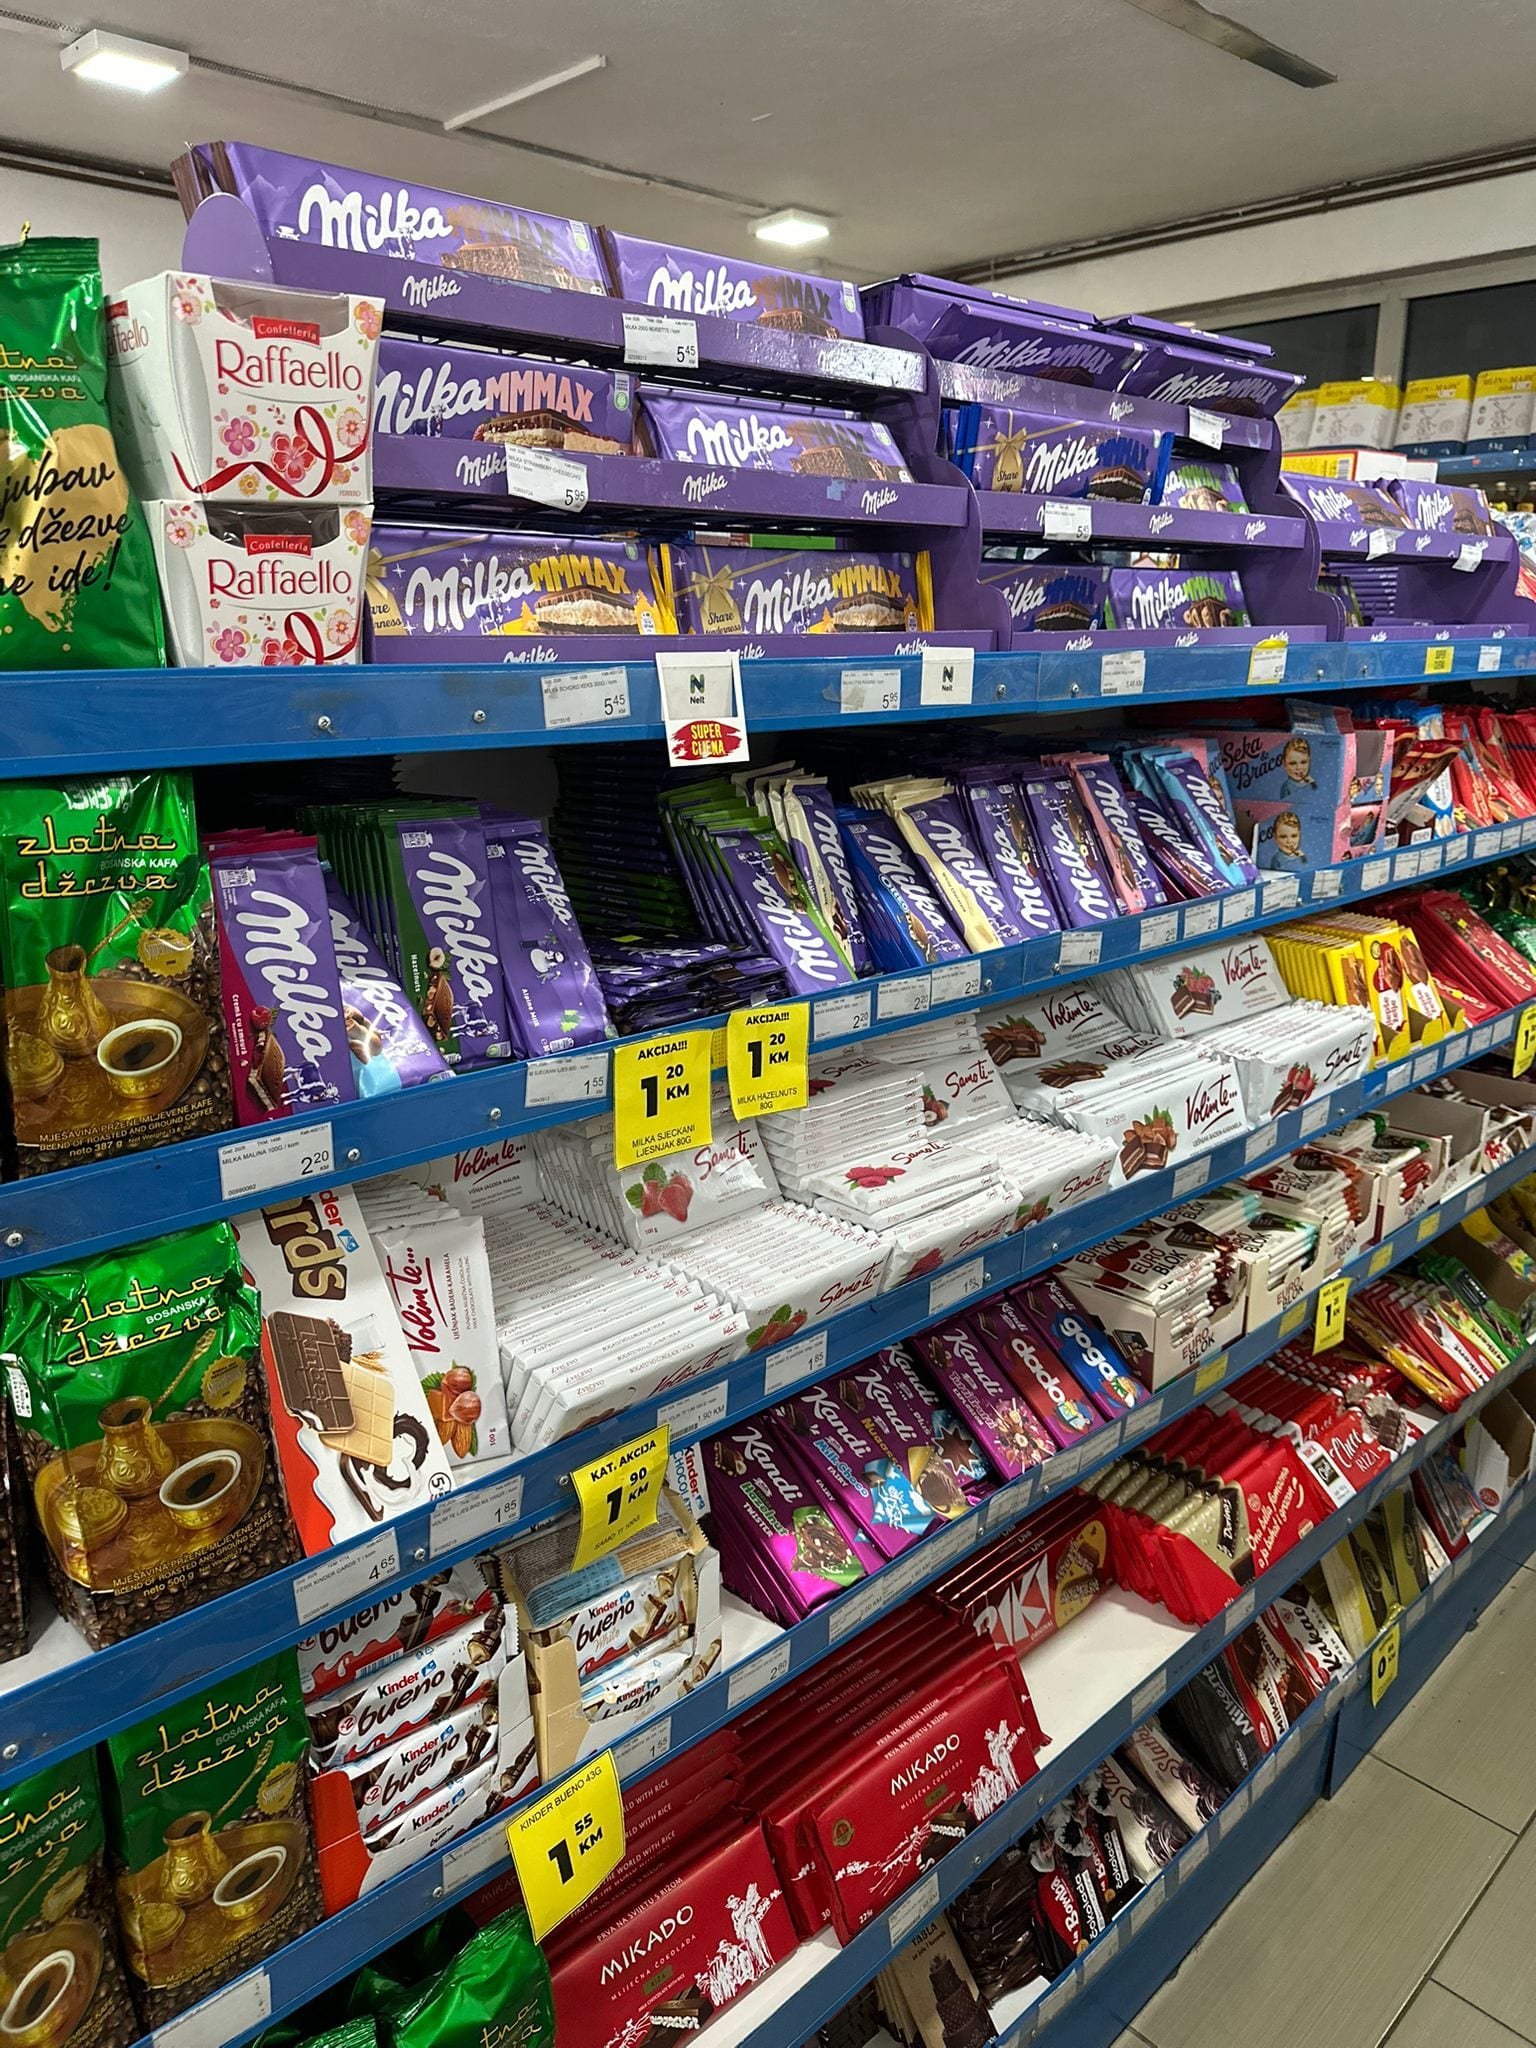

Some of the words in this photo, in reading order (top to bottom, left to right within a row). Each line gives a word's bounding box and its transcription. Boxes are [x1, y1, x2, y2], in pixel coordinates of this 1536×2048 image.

[401, 274, 462, 308] Milka
[646, 265, 757, 315] Milka
[257, 323, 317, 341] Confetteria
[215, 339, 362, 391] Raffaello
[374, 361, 489, 434] Milka
[485, 370, 594, 422] MMMAX
[1026, 437, 1100, 494] Milka
[682, 471, 729, 502] Milka
[861, 487, 899, 515] Milka
[249, 538, 310, 556] Confetteria
[207, 558, 352, 598] Raffaello
[405, 555, 537, 633] Milka
[529, 554, 632, 595] MMMAX
[707, 611, 735, 626] Share
[743, 568, 836, 634] Milka
[831, 564, 902, 598] MMMAX
[689, 695, 705, 705] Nelt
[690, 723, 721, 740] SUPER
[691, 738, 725, 757] CIJENA
[1221, 735, 1263, 772] Seka
[1231, 751, 1285, 791] Braco
[17, 815, 177, 857] zlatna
[1095, 779, 1146, 871] Milka
[100, 858, 146, 870] BOSANSKA
[149, 857, 178, 870] KAFA
[513, 839, 573, 926] Milka
[866, 834, 945, 932] Milka
[928, 819, 1001, 918] Milka
[993, 826, 1051, 930] Milka
[1051, 818, 1108, 920] Milka
[416, 850, 499, 1007] Milka
[752, 872, 838, 981] Milka
[236, 890, 339, 1068] Milka
[409, 953, 421, 993] Hazelnuts
[521, 987, 534, 1013] Alpine
[529, 1011, 541, 1029] Milk
[746, 1012, 789, 1025] AKCIJA!!!
[637, 1040, 688, 1060] AKCIJA!!!
[769, 1033, 785, 1046] 20
[769, 1050, 789, 1065] KM
[666, 1064, 683, 1078] 20
[747, 1041, 762, 1079] 1
[641, 1075, 659, 1118] 1
[666, 1083, 690, 1100] KM
[737, 1094, 757, 1105] MILKA
[757, 1086, 797, 1102] HAZELNUTS
[760, 1101, 773, 1111] 80G
[129, 1126, 147, 1136] AND
[149, 1117, 184, 1131] GROUND
[185, 1106, 215, 1121] COFFEE
[632, 1134, 658, 1149] MILKA
[659, 1124, 696, 1143] SJECKANI
[222, 1155, 242, 1165] MILKA
[243, 1149, 266, 1159] MALINA
[301, 1156, 314, 1176] 2
[313, 1150, 329, 1164] 20
[636, 1141, 675, 1158] LJESNJAK
[676, 1136, 692, 1148] 80G
[444, 1252, 452, 1289] KARAMELA
[62, 1273, 226, 1334] zlatna
[145, 1297, 207, 1325] BOSANSKA
[447, 1289, 456, 1311] BADEM
[1045, 1280, 1078, 1312] Kandi
[997, 1301, 1029, 1333] Kandi
[943, 1327, 1004, 1397] Kandi
[1059, 1317, 1119, 1382] goga
[1182, 1327, 1209, 1360] EURO
[1188, 1332, 1215, 1365] BLOK
[887, 1342, 940, 1406] Kandi
[1011, 1338, 1066, 1404] dado
[801, 1386, 872, 1459] Kandi
[855, 1368, 918, 1442] Kandi
[590, 1462, 618, 1483] KAT.
[619, 1440, 657, 1467] AKCIJA
[629, 1466, 648, 1487] 90
[732, 1426, 803, 1504] Kandi
[606, 1487, 624, 1525] 1
[628, 1482, 650, 1504] KM
[739, 1481, 790, 1537] Hazelnut
[625, 1514, 641, 1531] 100G
[743, 1502, 774, 1538] TWISTER
[113, 1562, 170, 1588] MJEŠAVINA
[171, 1549, 208, 1568] PRŽENE
[209, 1524, 253, 1552] MLJEVENE
[254, 1510, 274, 1528] KAFE
[199, 1553, 215, 1564] AND
[216, 1537, 248, 1556] GROUND
[249, 1517, 275, 1538] COFFEE
[576, 1599, 635, 1652] bueno
[588, 1598, 619, 1621] Kinder
[357, 1667, 446, 1739] bueno
[377, 1670, 420, 1700] Kinder
[1202, 1664, 1255, 1737] Milkent
[136, 1682, 284, 1769] zlatna
[214, 1708, 264, 1747] BOSANSKA
[264, 1695, 289, 1717] KAFA
[883, 1744, 902, 1761] PRVA
[901, 1739, 911, 1750] NA
[931, 1710, 950, 1726] RIŽOM
[381, 1731, 461, 1806] bueno
[399, 1736, 440, 1768] Kinder
[890, 1733, 961, 1797] MIKADO
[519, 1801, 554, 1832] KINDER
[553, 1782, 586, 1813] BUENO
[585, 1765, 602, 1786] 43G
[636, 1789, 654, 1809] WITH
[654, 1778, 670, 1795] RICE
[412, 1797, 451, 1831] Kinder
[573, 1812, 594, 1837] 55
[578, 1826, 604, 1857] KM
[616, 1853, 642, 1877] WORLD
[641, 1841, 661, 1860] WITH
[660, 1829, 677, 1847] RICE
[547, 1838, 575, 1886] 1
[596, 1928, 618, 1943] PRVA
[617, 1916, 629, 1929] NA
[627, 1898, 655, 1923] SVIJETU
[659, 1876, 684, 1896] RIŽOM
[1050, 1875, 1080, 1933] Bomba
[600, 1904, 694, 1986] MIKADO
[910, 1922, 938, 1948] TABLA
[610, 1968, 652, 2002] MLIJEČNA
[653, 1933, 697, 1969] ČOKOLADA
[646, 1986, 669, 2006] CHOCOLATE
[676, 1972, 687, 1983] RICE
